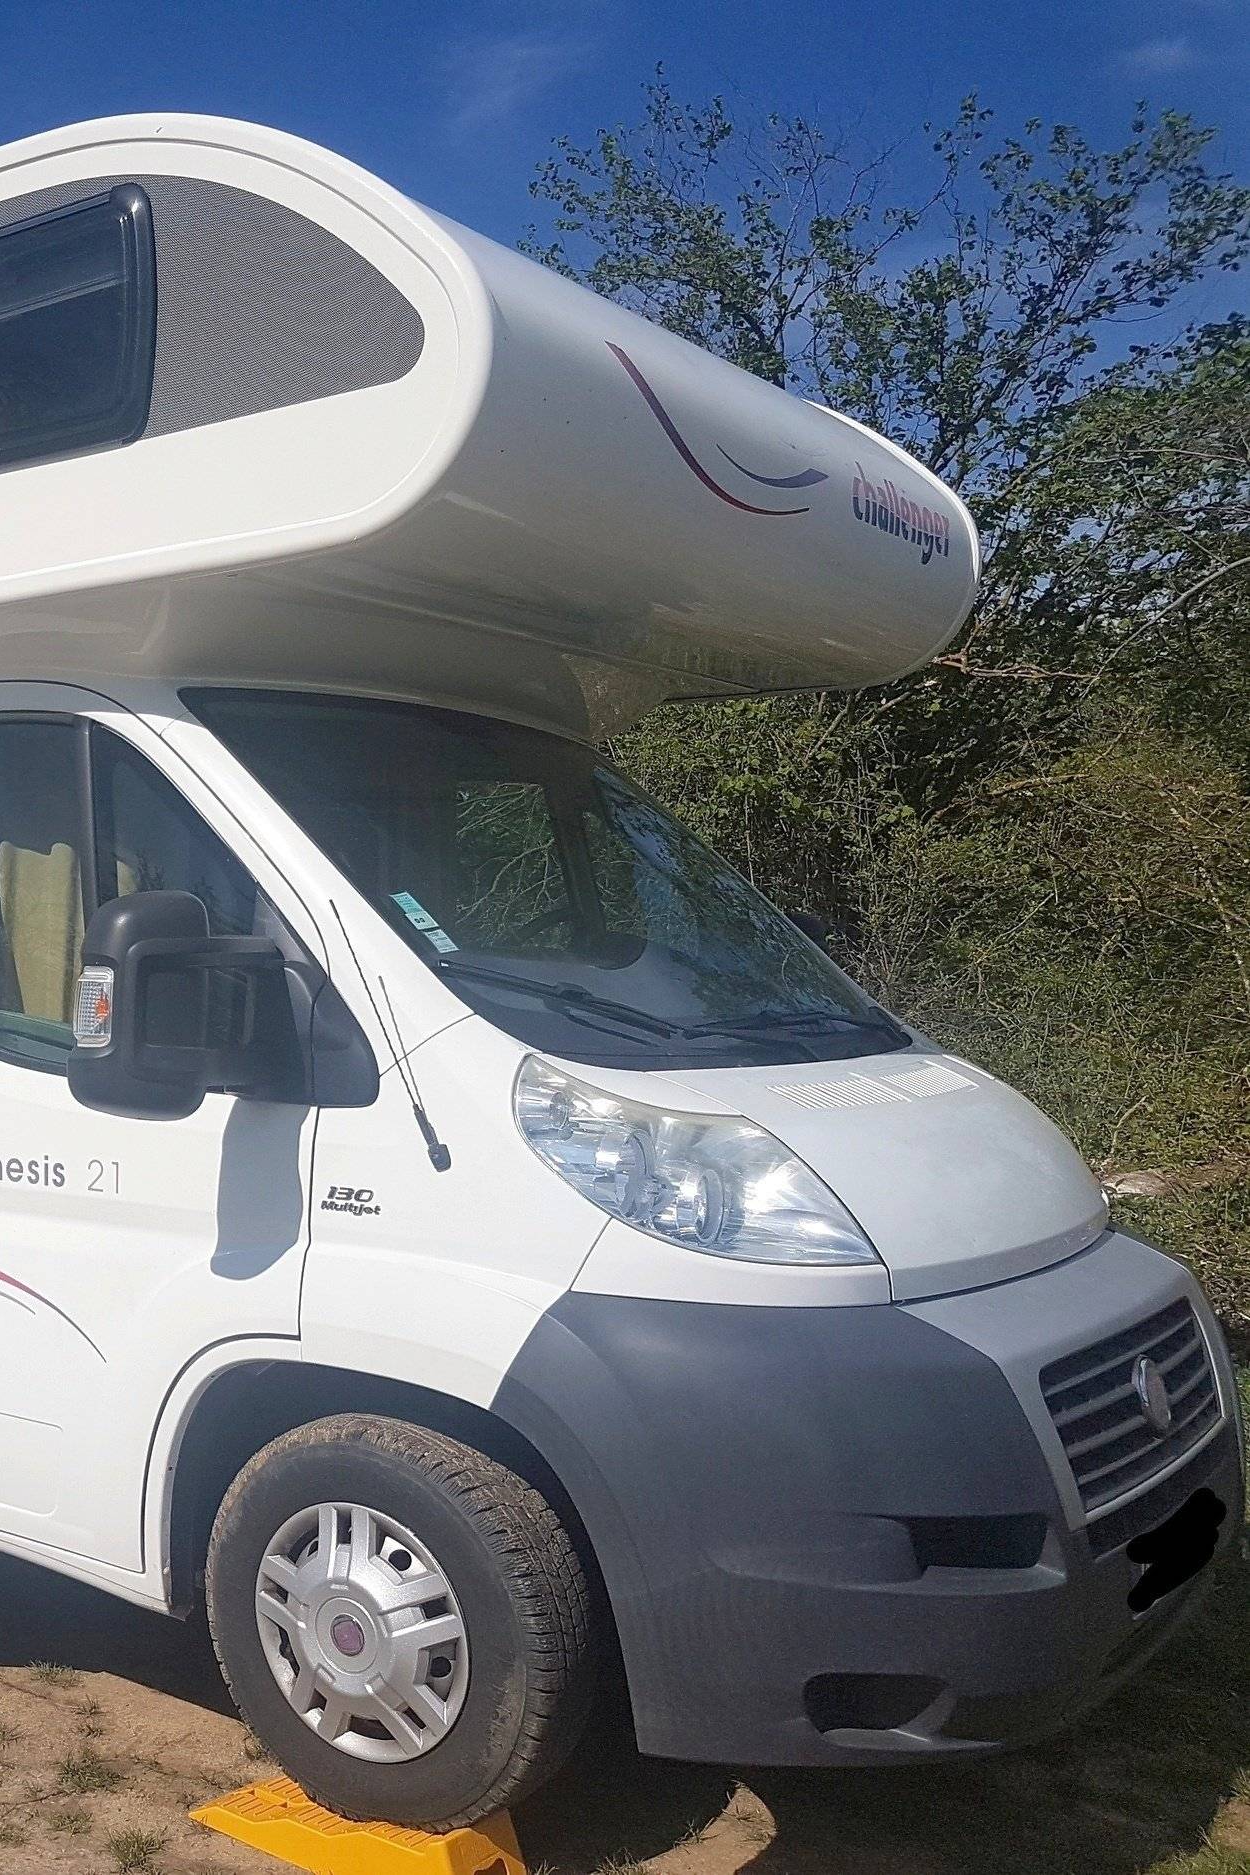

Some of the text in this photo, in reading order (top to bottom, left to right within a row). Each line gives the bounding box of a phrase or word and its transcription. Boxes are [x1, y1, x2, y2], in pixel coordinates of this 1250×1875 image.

[852, 461, 950, 565] challenger
[87, 1159, 119, 1194] 21
[327, 1185, 375, 1203] 130
